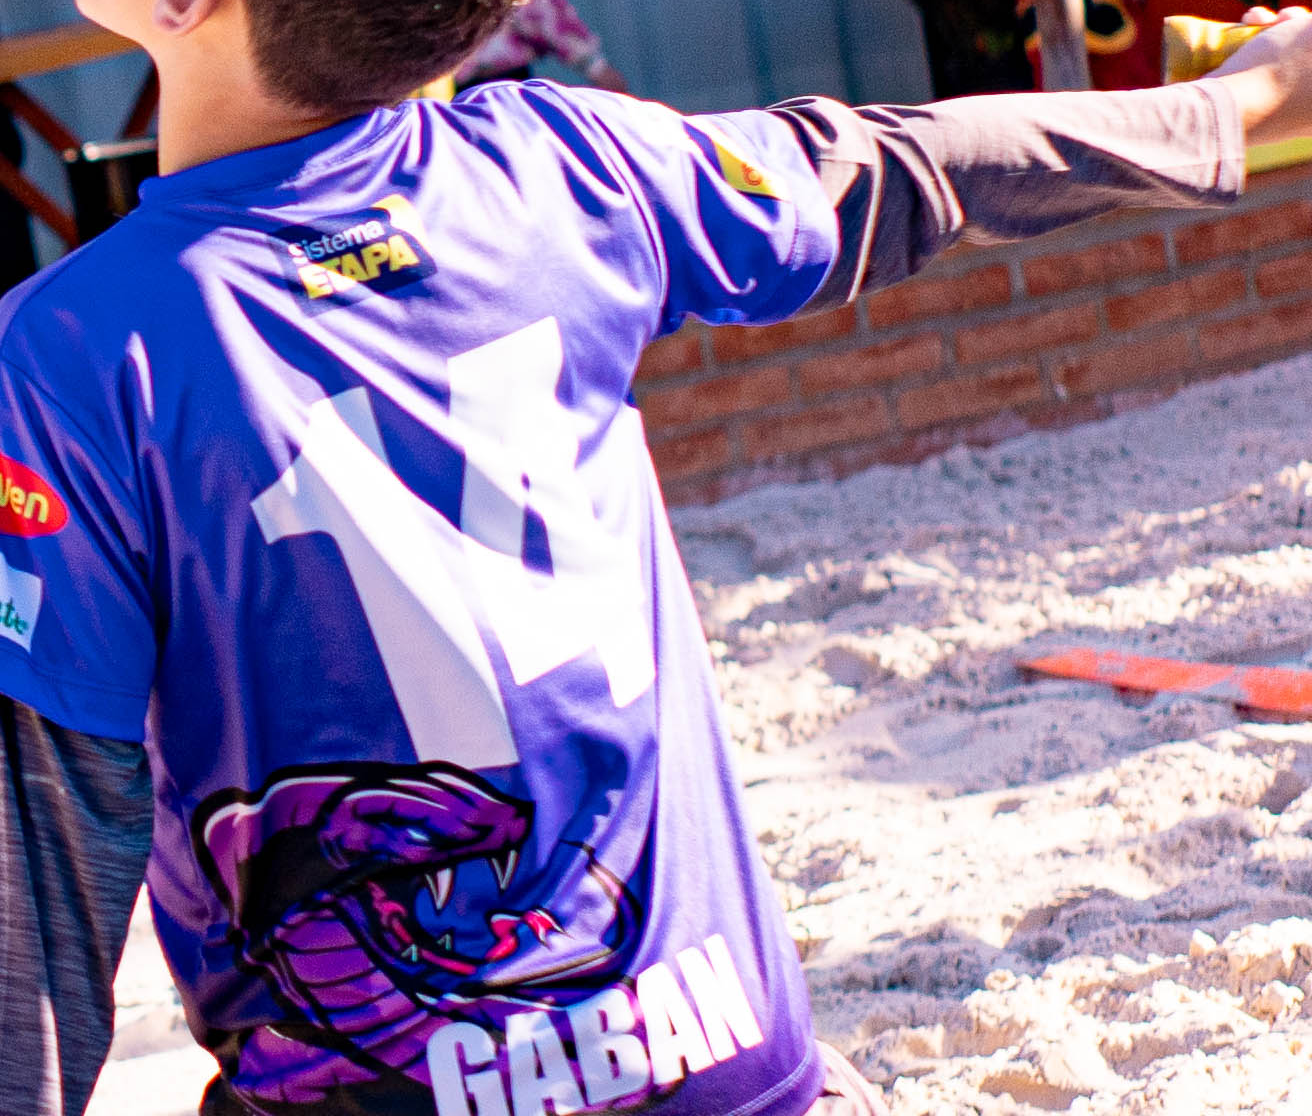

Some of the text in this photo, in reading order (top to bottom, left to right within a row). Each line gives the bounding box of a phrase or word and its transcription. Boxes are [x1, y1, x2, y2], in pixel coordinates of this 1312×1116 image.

[288, 220, 386, 265] Sistema
[298, 234, 421, 300] ETAPA
[426, 933, 765, 1116] GABAN
